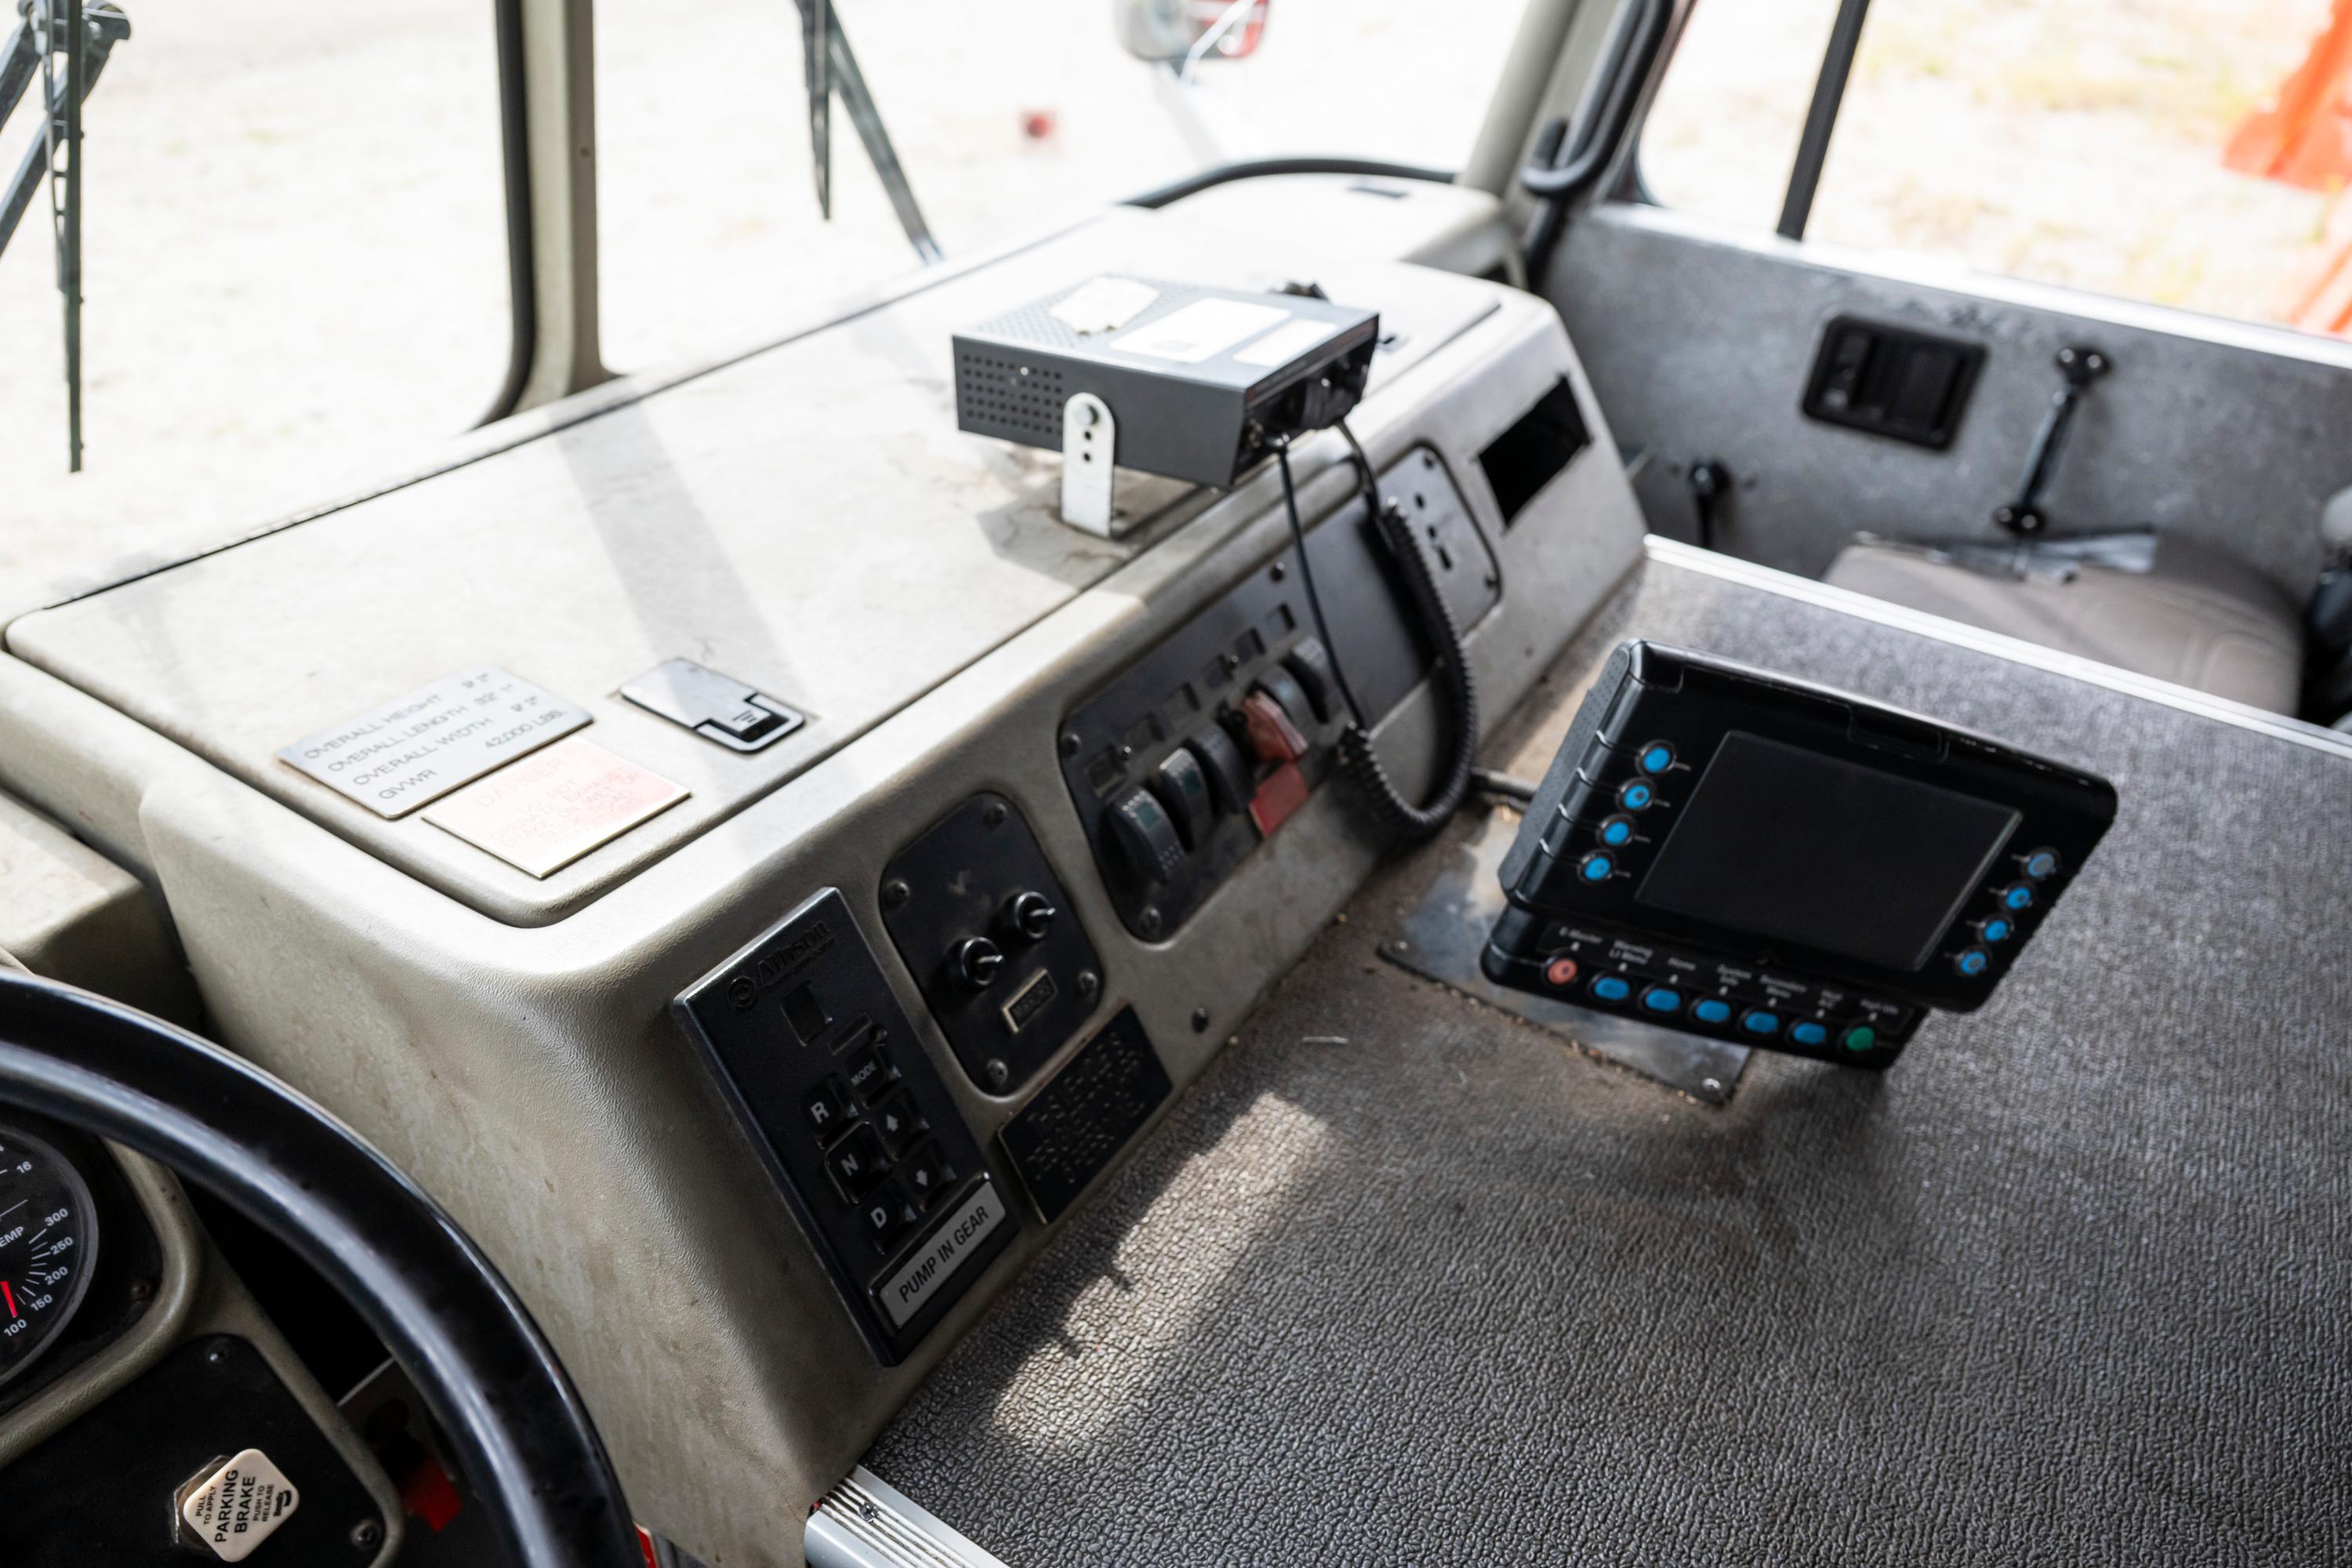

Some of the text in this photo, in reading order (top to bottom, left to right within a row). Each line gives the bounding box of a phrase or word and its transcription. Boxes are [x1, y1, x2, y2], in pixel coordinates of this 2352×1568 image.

[304, 723, 384, 759] OVERALL
[382, 694, 443, 724] HEIGHT
[328, 735, 404, 771] OVERALL
[403, 705, 468, 738] LENGTH
[353, 745, 438, 785] OVERALL
[435, 717, 493, 746] WIDTH
[379, 769, 438, 799] GVWR
[470, 756, 571, 808] DANGER
[851, 1061, 877, 1087] MODE
[810, 1101, 829, 1124] R
[16, 1160, 32, 1174] 16
[840, 1153, 859, 1176] N
[44, 1207, 69, 1227] 300
[869, 1207, 887, 1229] D
[0, 1225, 24, 1247] EMP
[50, 1236, 74, 1256] 250
[898, 1206, 989, 1303] PUMP IN GEAR
[45, 1266, 69, 1286] 200
[30, 1294, 53, 1312] 150
[3, 1318, 27, 1337] 100
[196, 1495, 206, 1516] PULL
[203, 1486, 216, 1525] TO APPLY
[215, 1469, 238, 1542] PARKING
[234, 1476, 256, 1533] BRAKE
[253, 1485, 265, 1521] PUSH TO
[262, 1483, 274, 1522] RELEASE
